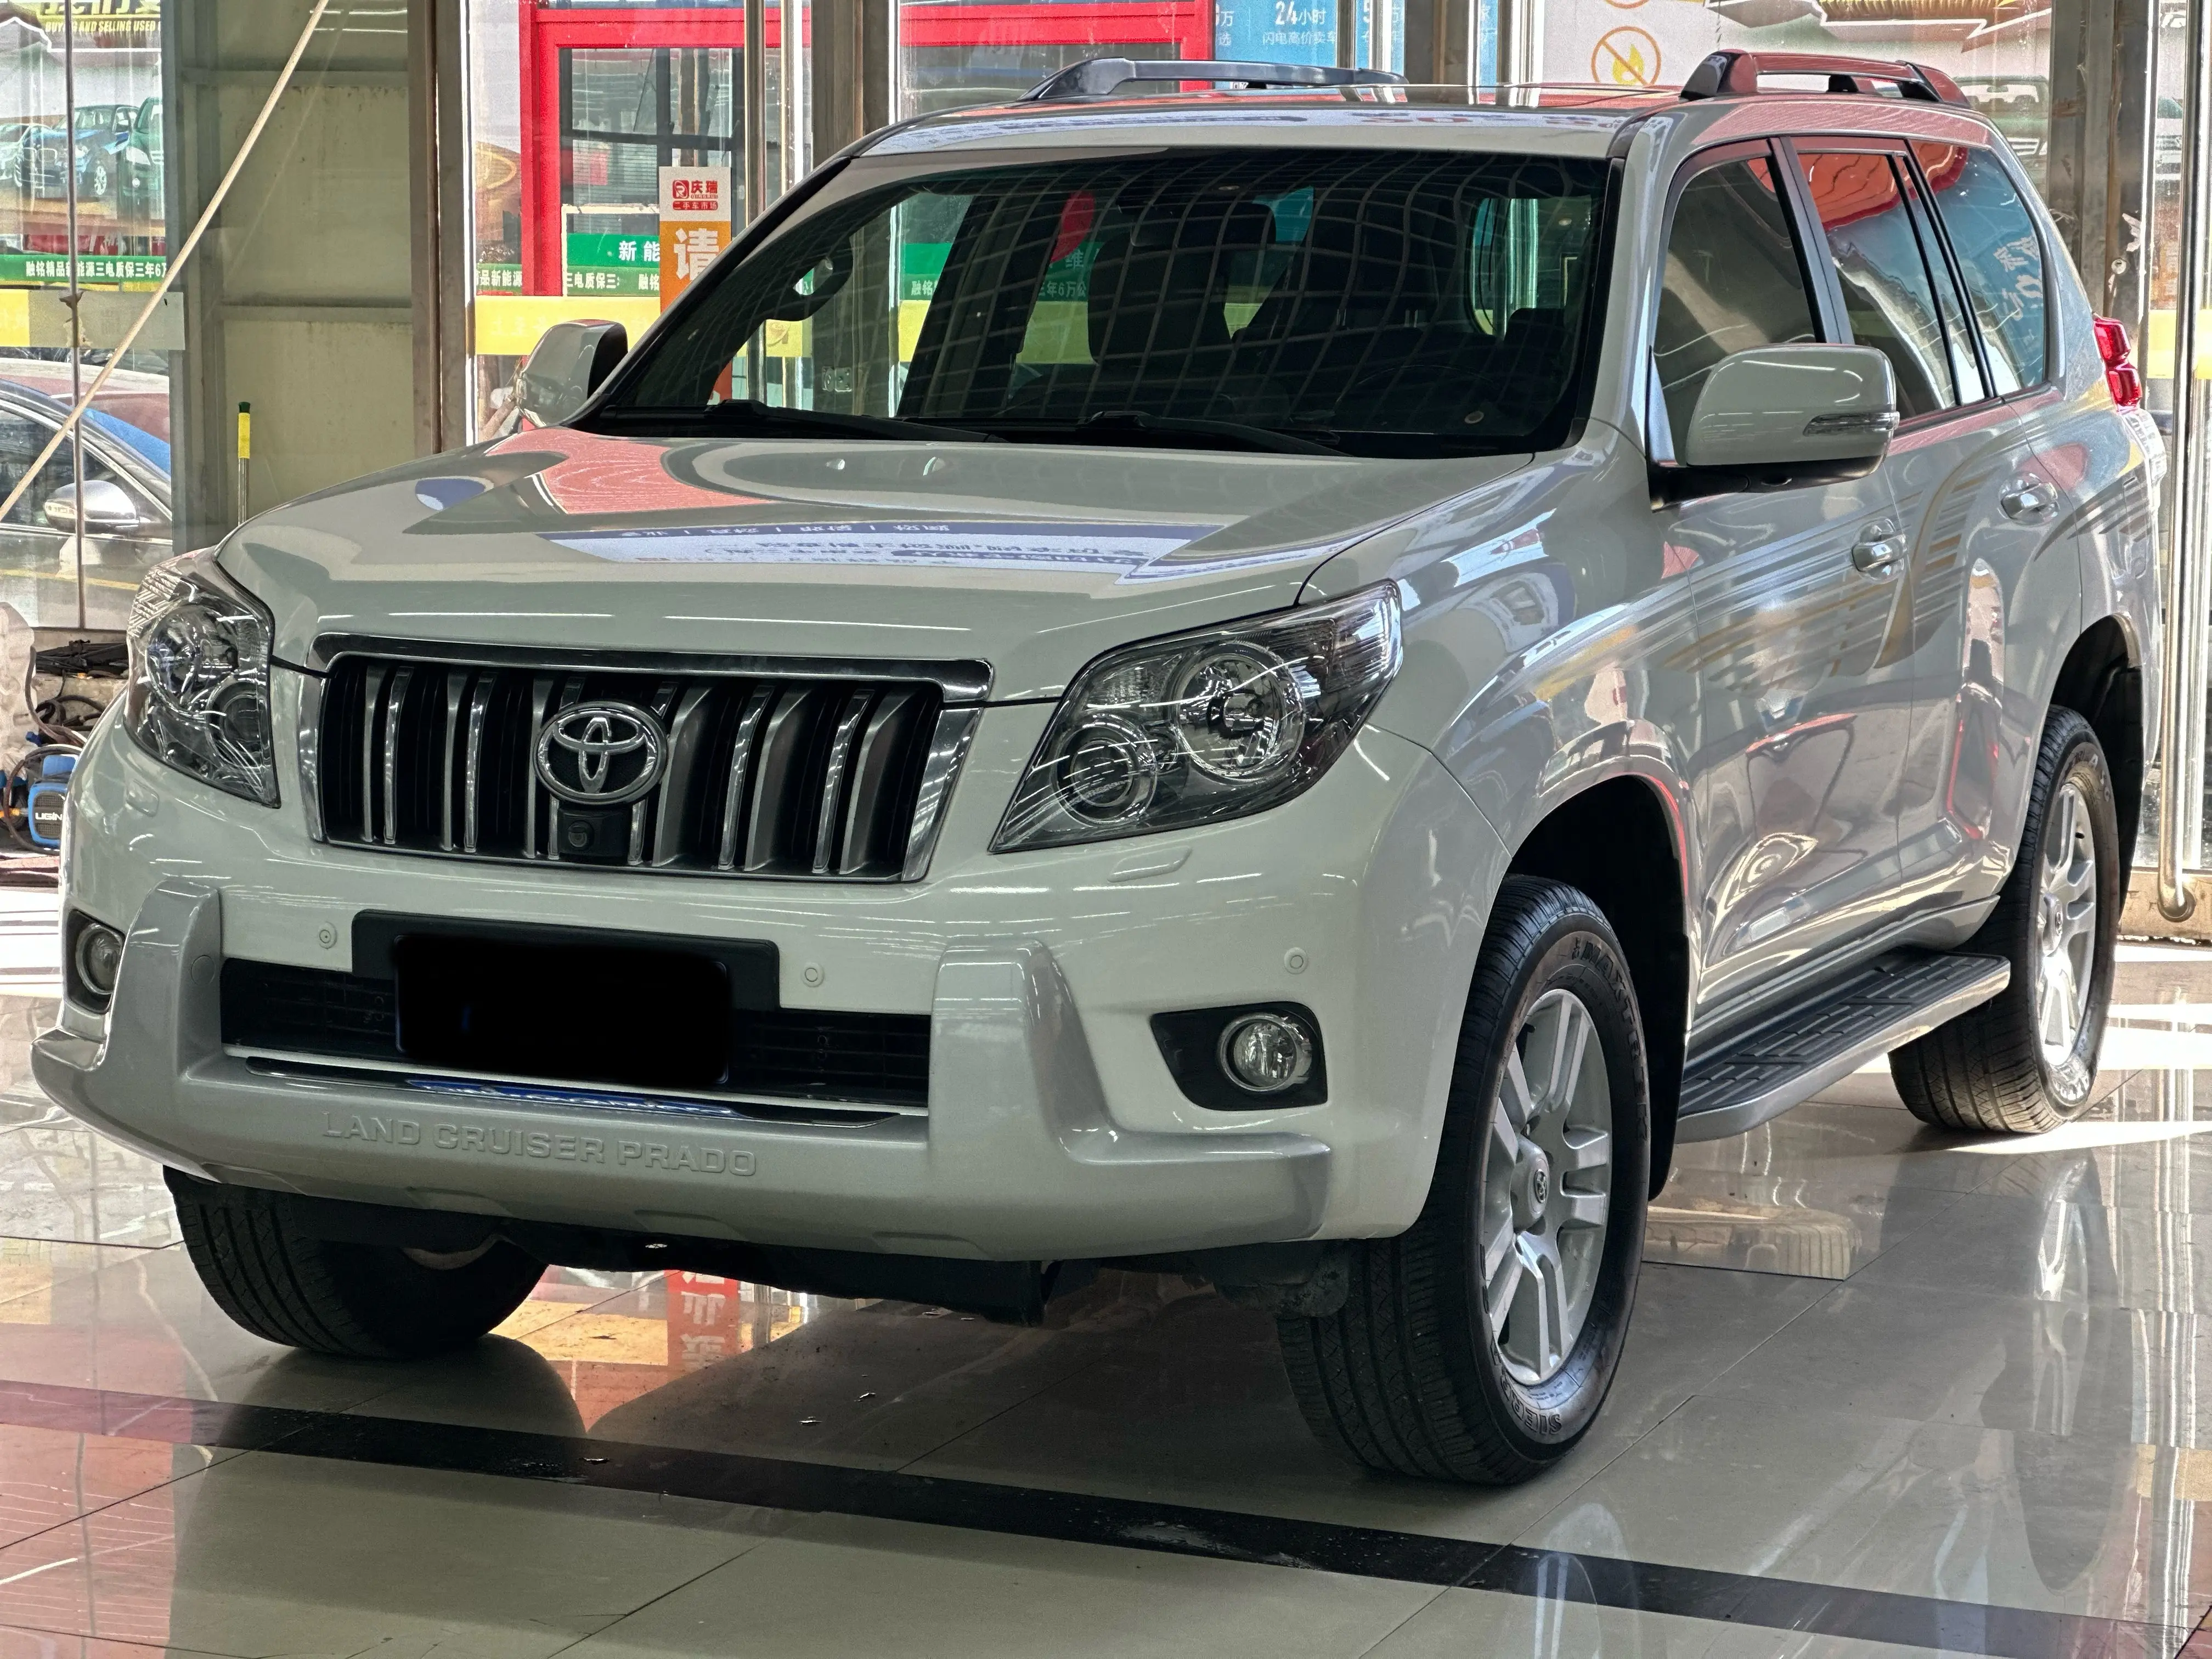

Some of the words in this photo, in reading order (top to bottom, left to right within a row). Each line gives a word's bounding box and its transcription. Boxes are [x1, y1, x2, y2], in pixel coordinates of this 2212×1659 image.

[1275, 1, 1326, 25] 24小时
[78, 21, 98, 32] AND
[98, 21, 132, 32] SELLING
[133, 20, 156, 31] USED
[691, 180, 718, 194] 庆瑞
[674, 202, 718, 210] 二手车市场
[618, 241, 660, 262] 新能
[674, 228, 719, 281] 请
[566, 272, 620, 289] 三电质保三
[322, 1111, 421, 1146] LAND
[433, 1122, 606, 1164] CRUISER
[617, 1139, 758, 1177] PRADO
